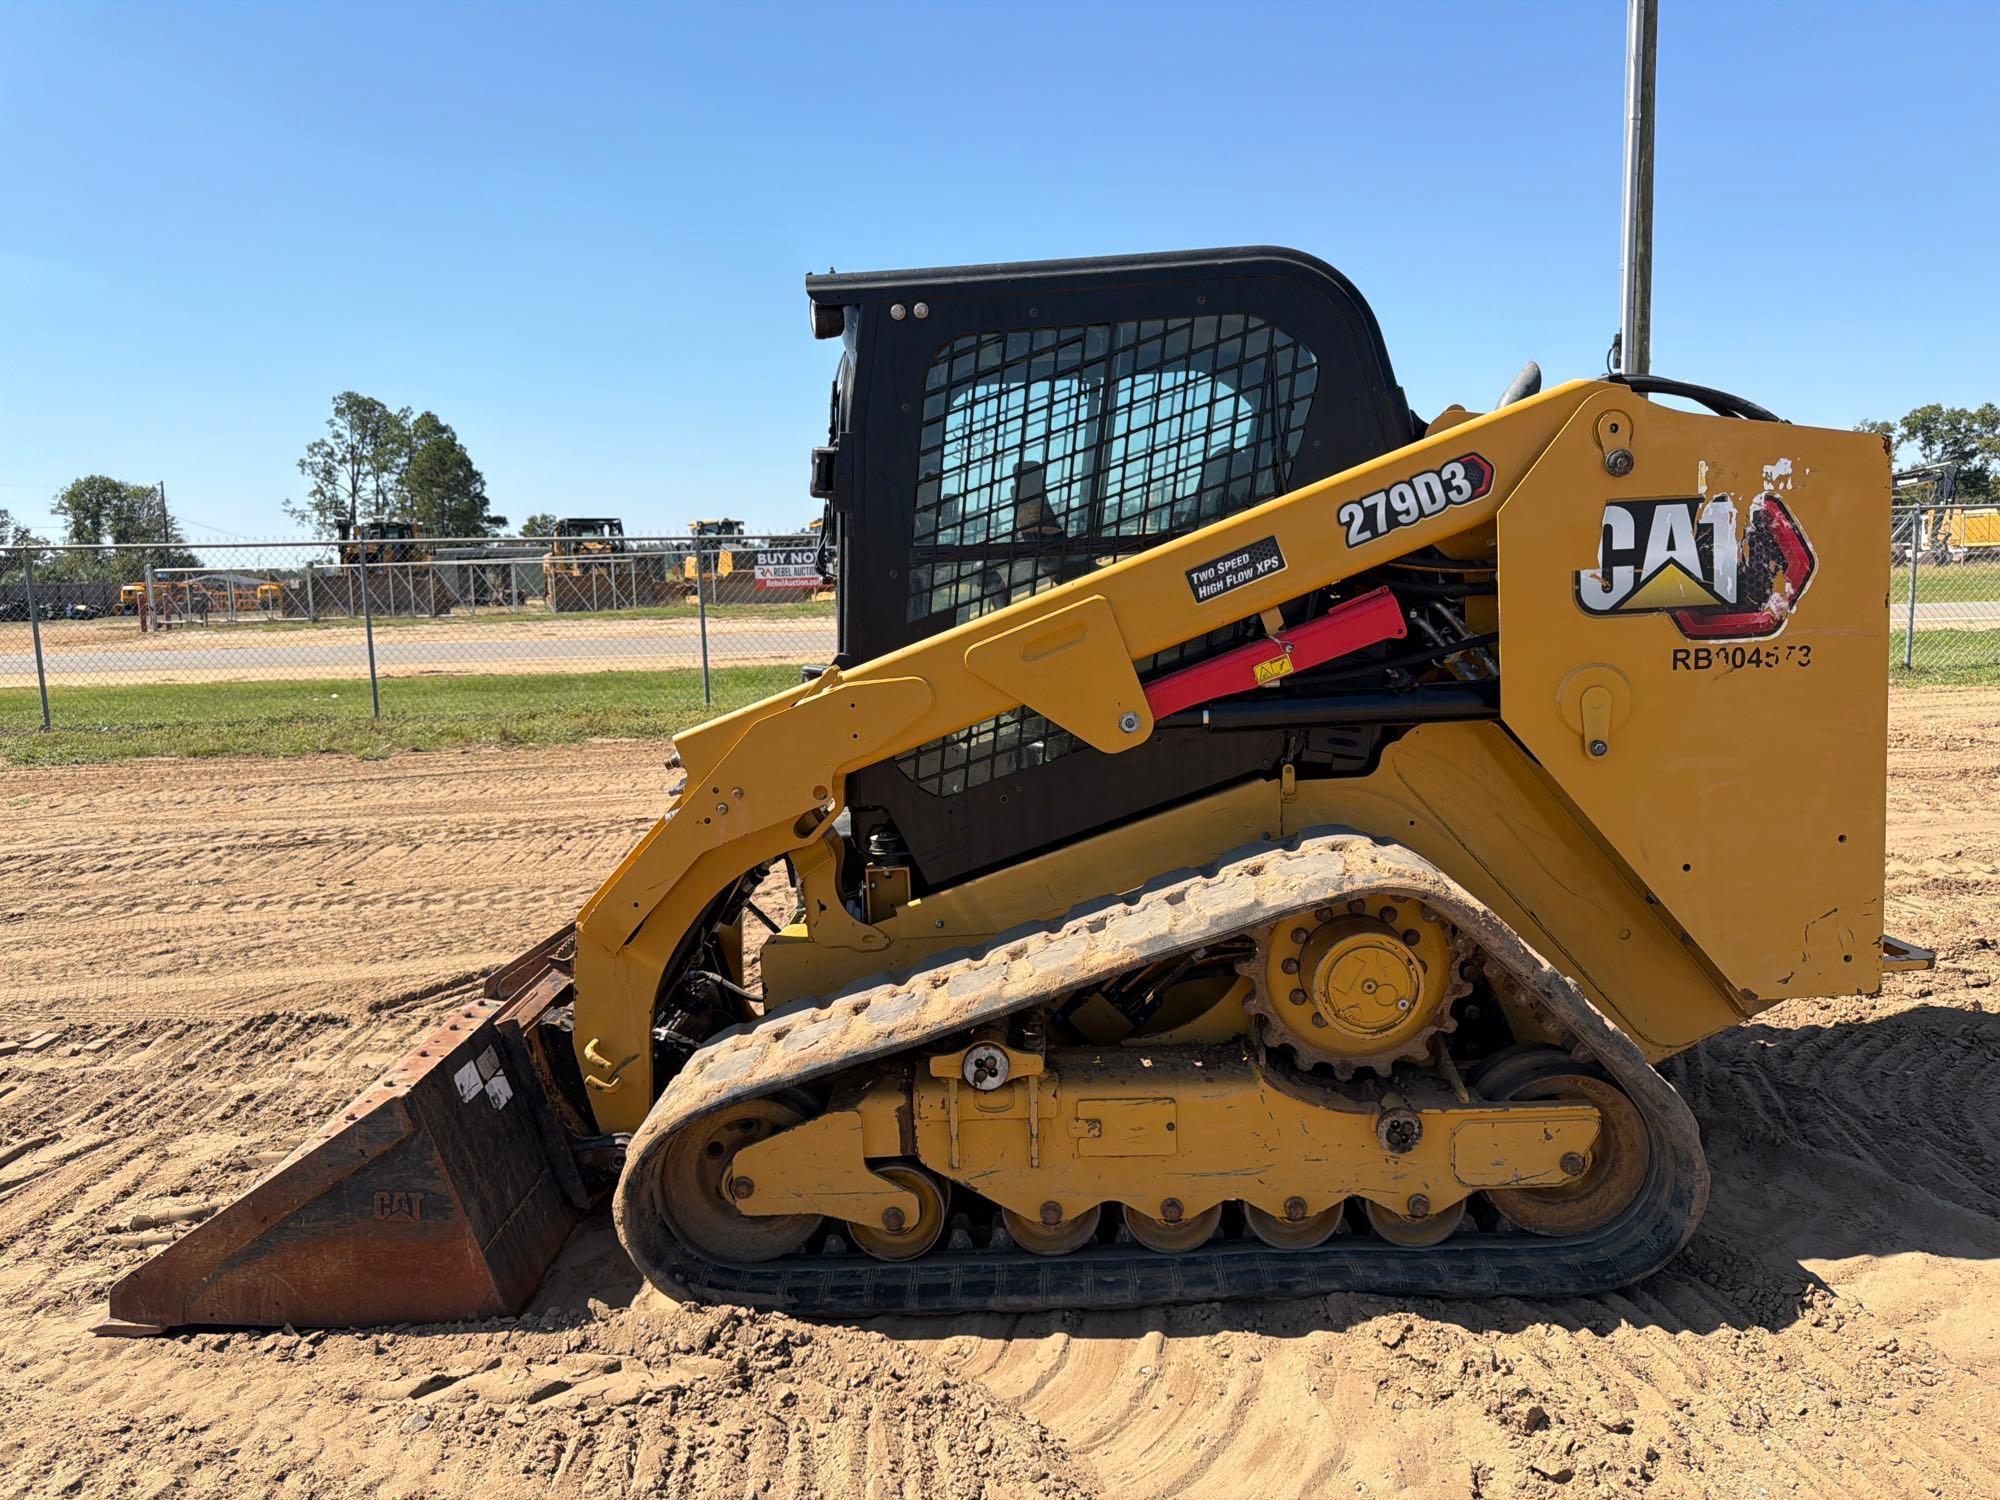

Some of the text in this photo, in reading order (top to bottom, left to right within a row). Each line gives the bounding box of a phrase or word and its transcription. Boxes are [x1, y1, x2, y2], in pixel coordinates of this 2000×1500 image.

[1339, 461, 1473, 546] 279D3
[757, 552, 786, 564] BUY
[1256, 556, 1279, 575] XPS
[1580, 502, 1737, 609] CAT
[774, 566, 818, 576] REBEL AUCTIO
[374, 1191, 425, 1223] CAT
